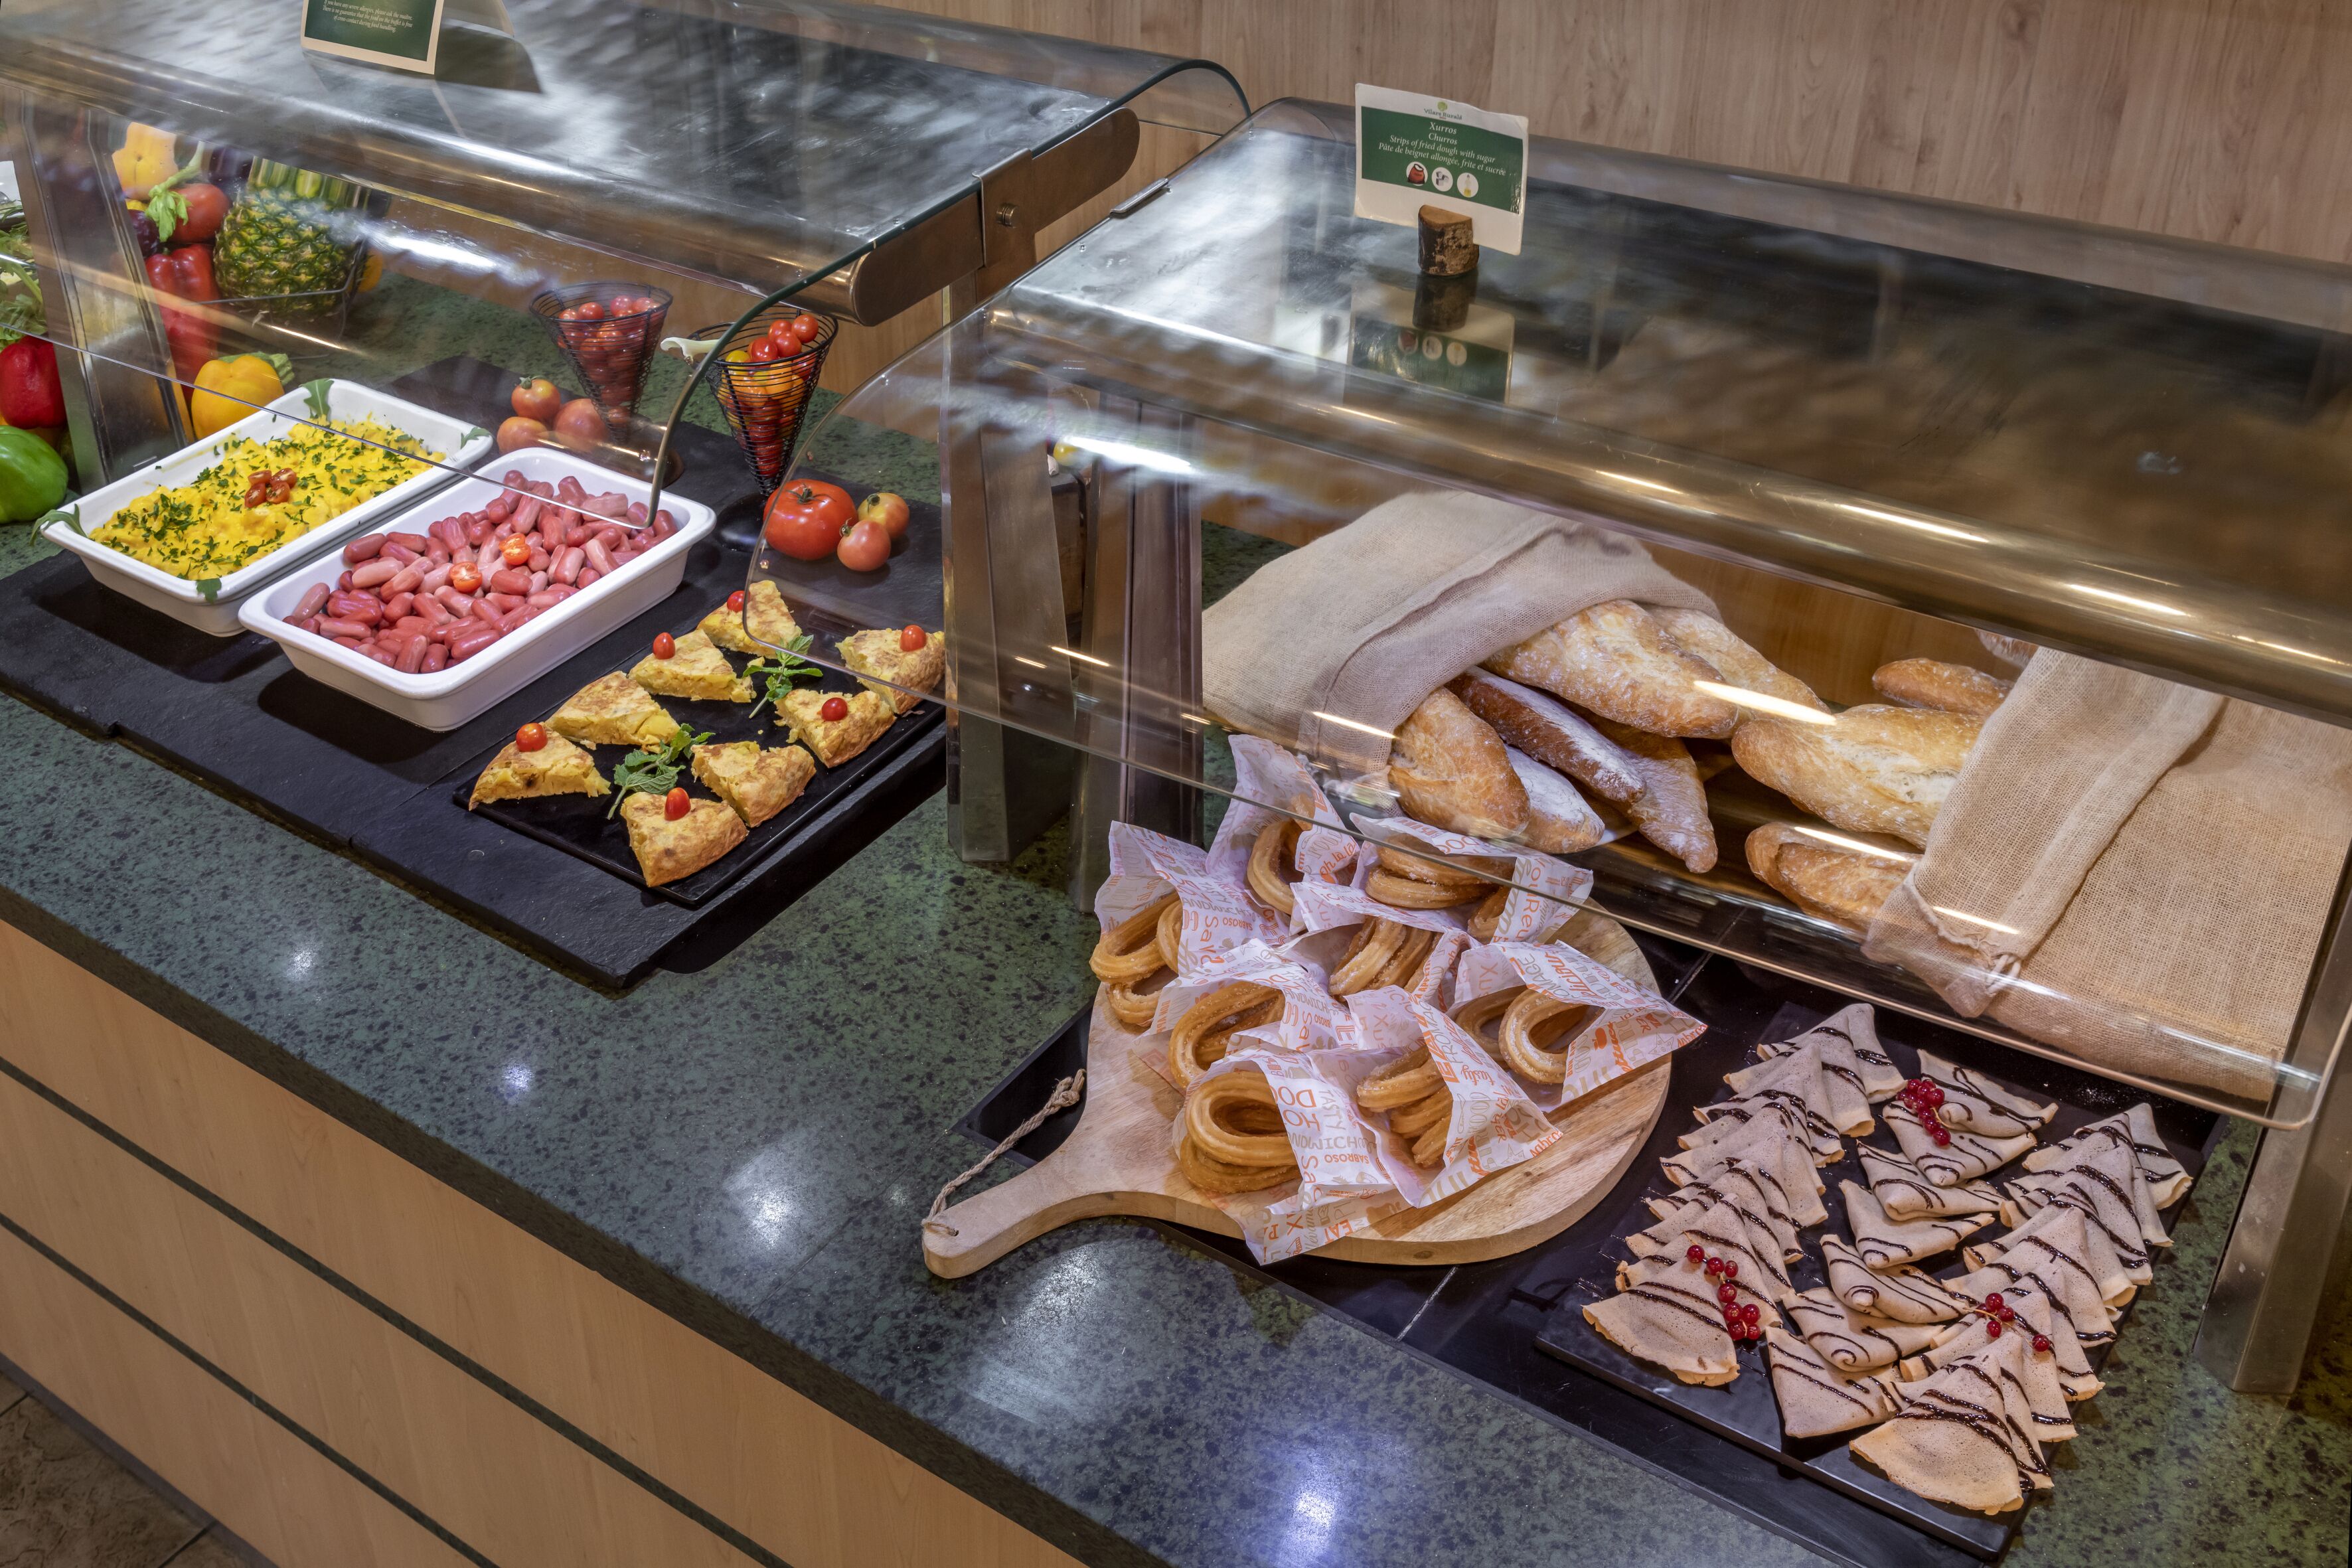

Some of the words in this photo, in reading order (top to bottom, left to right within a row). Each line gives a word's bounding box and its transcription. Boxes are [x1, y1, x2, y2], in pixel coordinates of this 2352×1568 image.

[1429, 121, 1457, 135] Xurros
[1429, 132, 1458, 145] Churros
[1389, 135, 1409, 147] Strips
[1411, 139, 1419, 148] of
[1417, 140, 1435, 150] fried
[1437, 144, 1458, 156] dough
[1460, 150, 1475, 159] with
[1476, 153, 1496, 164] sugar
[1379, 142, 1394, 152] Pâte
[1395, 145, 1403, 154] de
[1405, 147, 1429, 159] beignet
[1431, 153, 1460, 165] allongée,
[1460, 159, 1476, 169] frite
[1485, 167, 1506, 177] sucrée
[1222, 916, 1253, 931] SABROSO
[1461, 1064, 1496, 1087] tasty
[1318, 1089, 1347, 1131] TASTY
[1324, 1152, 1370, 1165] SABROSO
